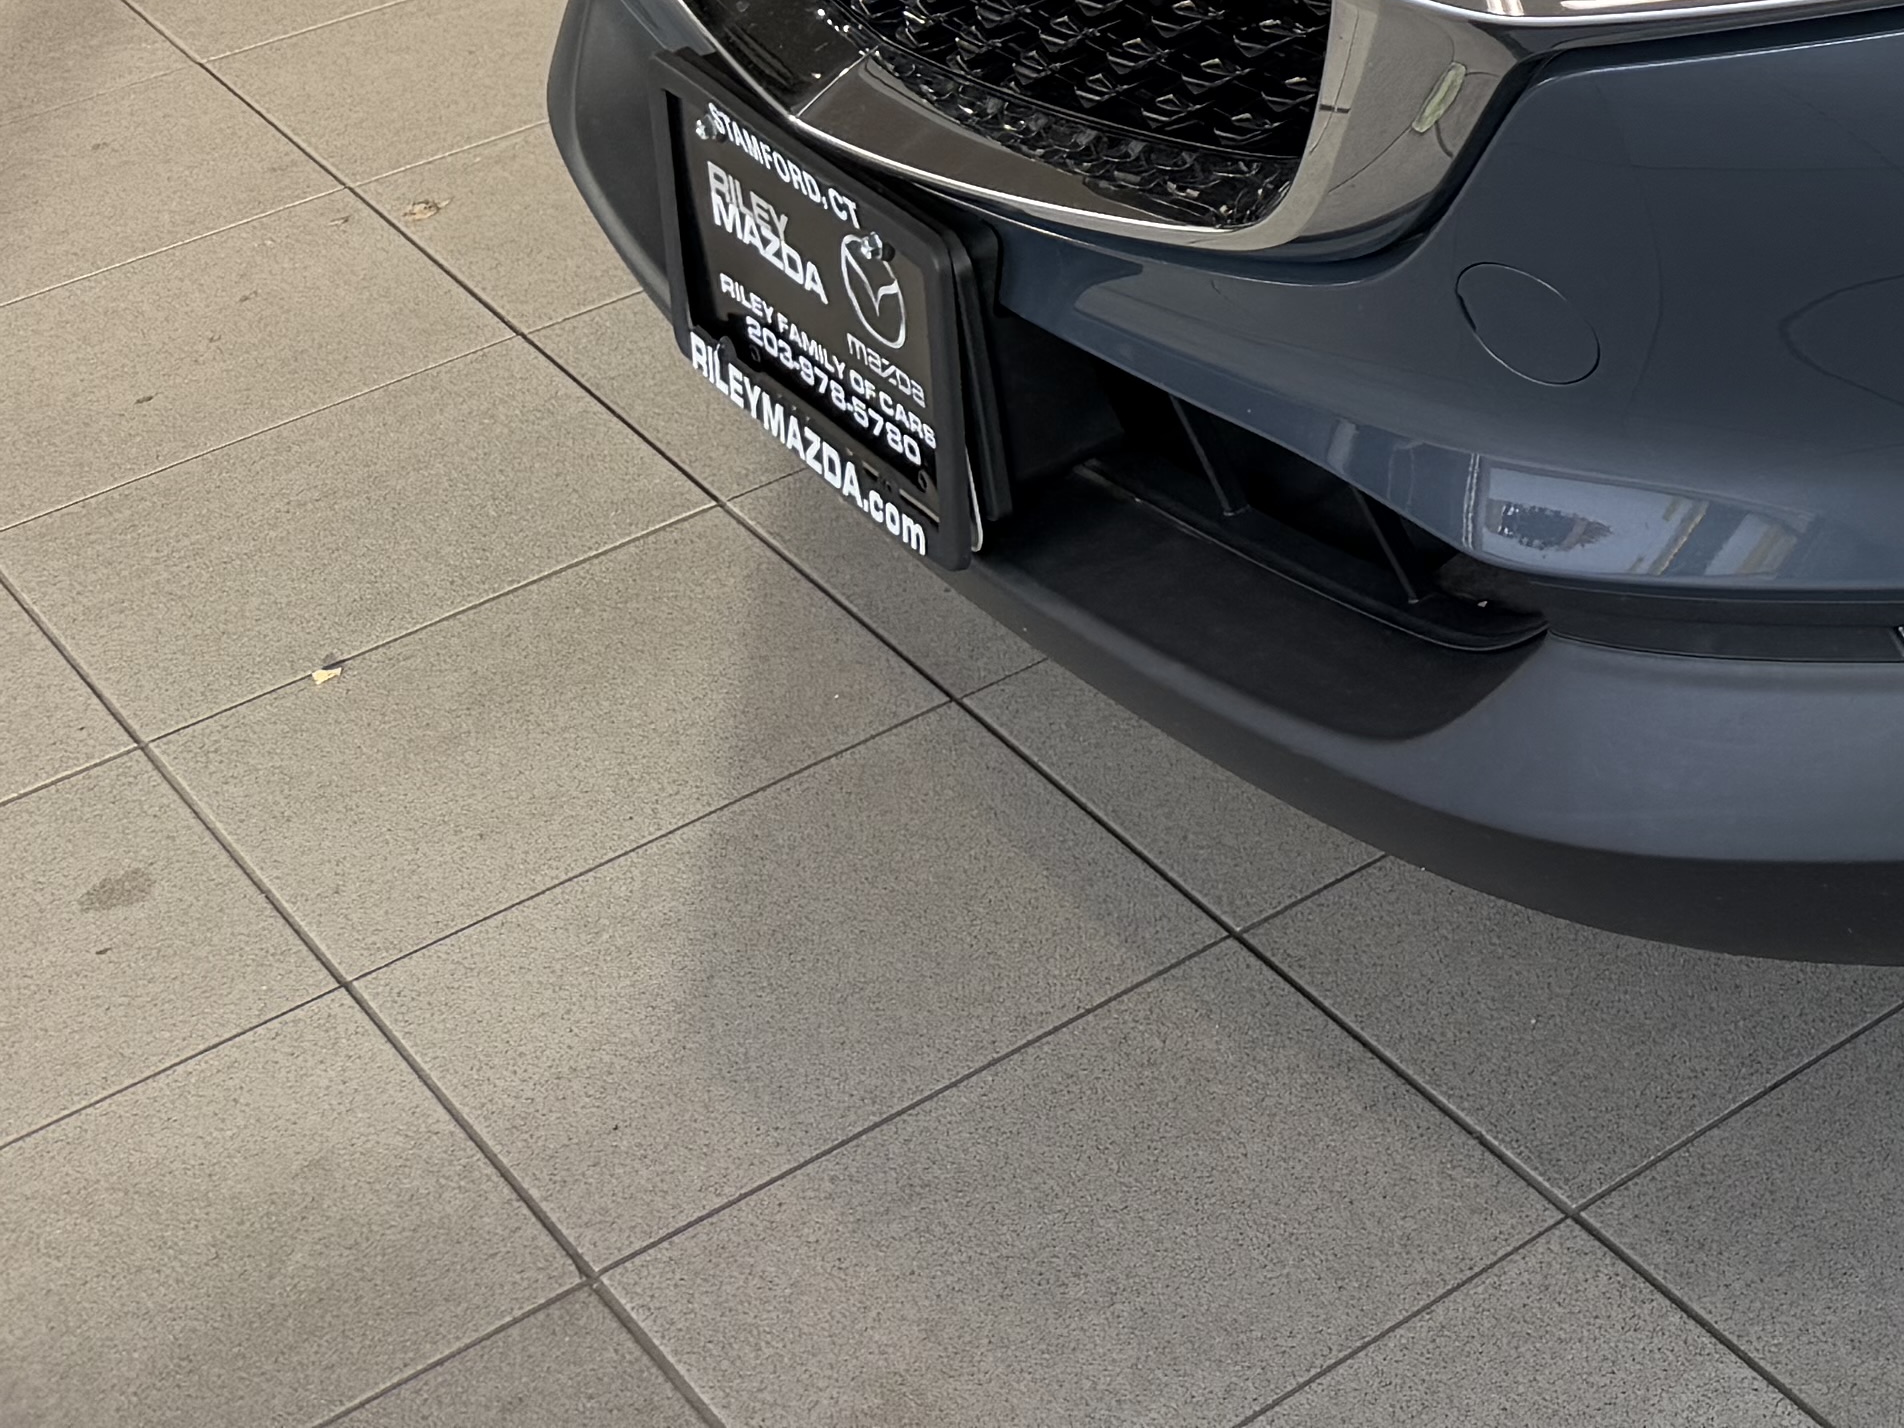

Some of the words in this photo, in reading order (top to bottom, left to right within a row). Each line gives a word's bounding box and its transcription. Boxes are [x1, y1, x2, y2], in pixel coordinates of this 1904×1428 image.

[707, 160, 788, 242] RILEY
[708, 102, 828, 210] STAMFORD,
[828, 187, 861, 230] CT
[711, 191, 829, 306] MAZDA
[719, 272, 775, 324] RILEY
[777, 312, 846, 380] FAMILY
[849, 369, 877, 401] OF
[878, 390, 937, 449] CARS
[690, 331, 927, 556] RILEYMAZDA.com
